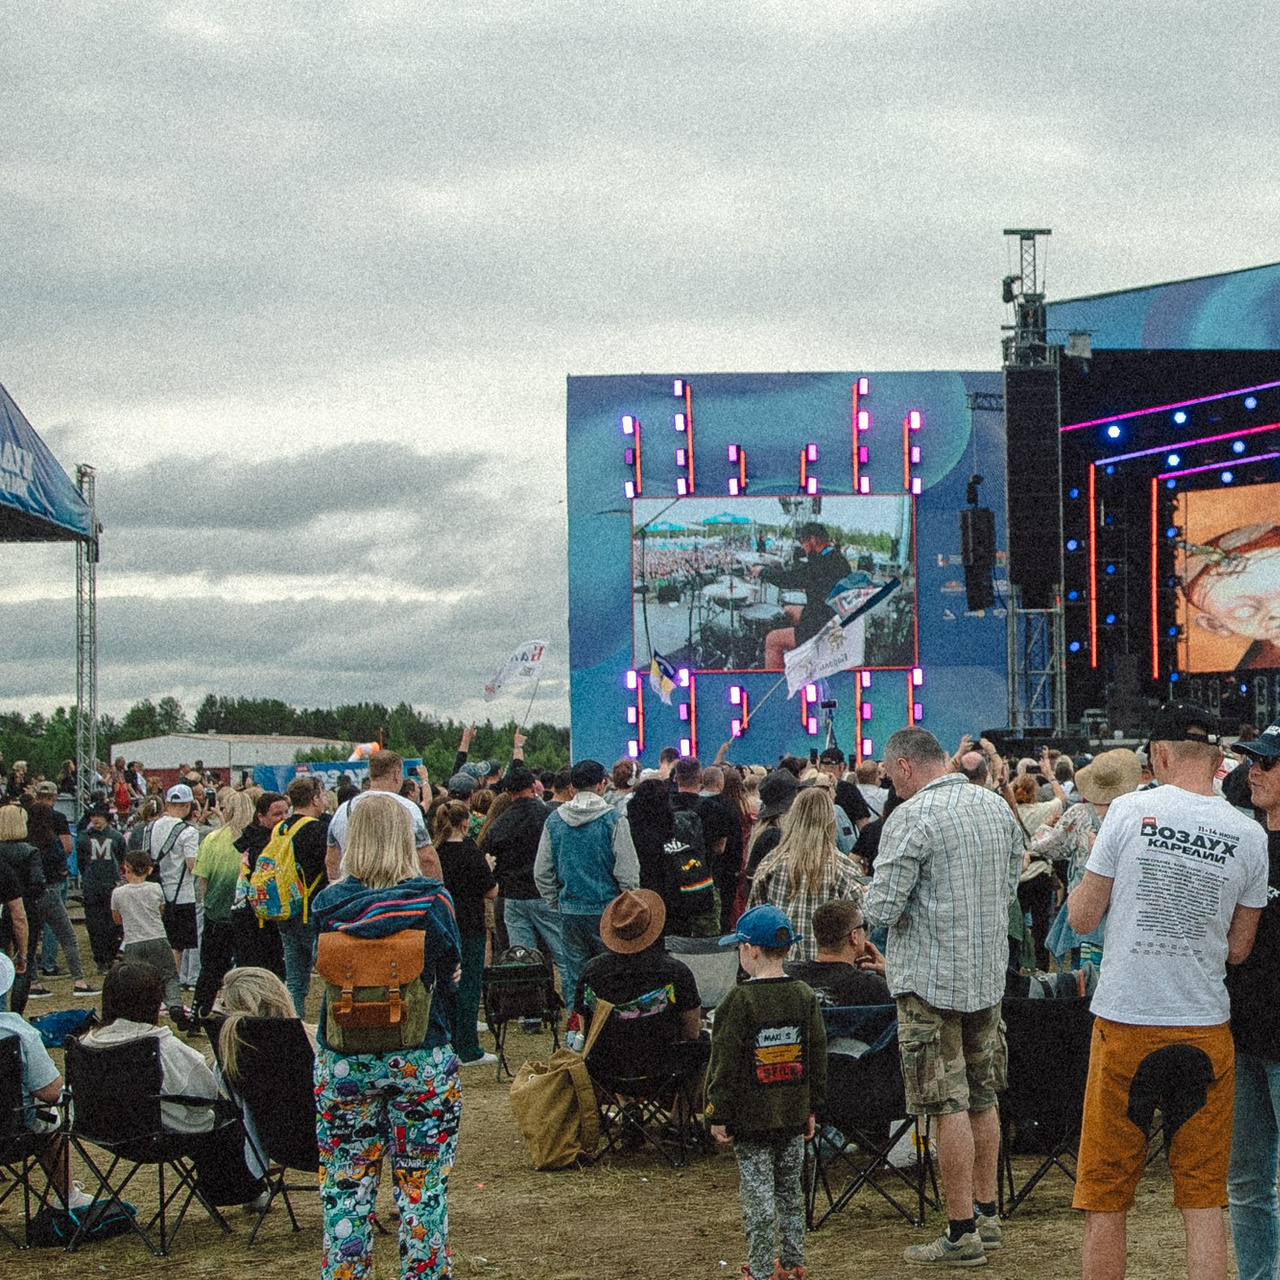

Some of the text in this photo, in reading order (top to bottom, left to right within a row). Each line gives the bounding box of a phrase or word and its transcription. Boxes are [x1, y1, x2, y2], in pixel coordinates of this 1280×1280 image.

[90, 838, 113, 860] M
[1140, 824, 1238, 858] ВОЗДУХ
[1147, 838, 1227, 865] КАРЕЛИИ
